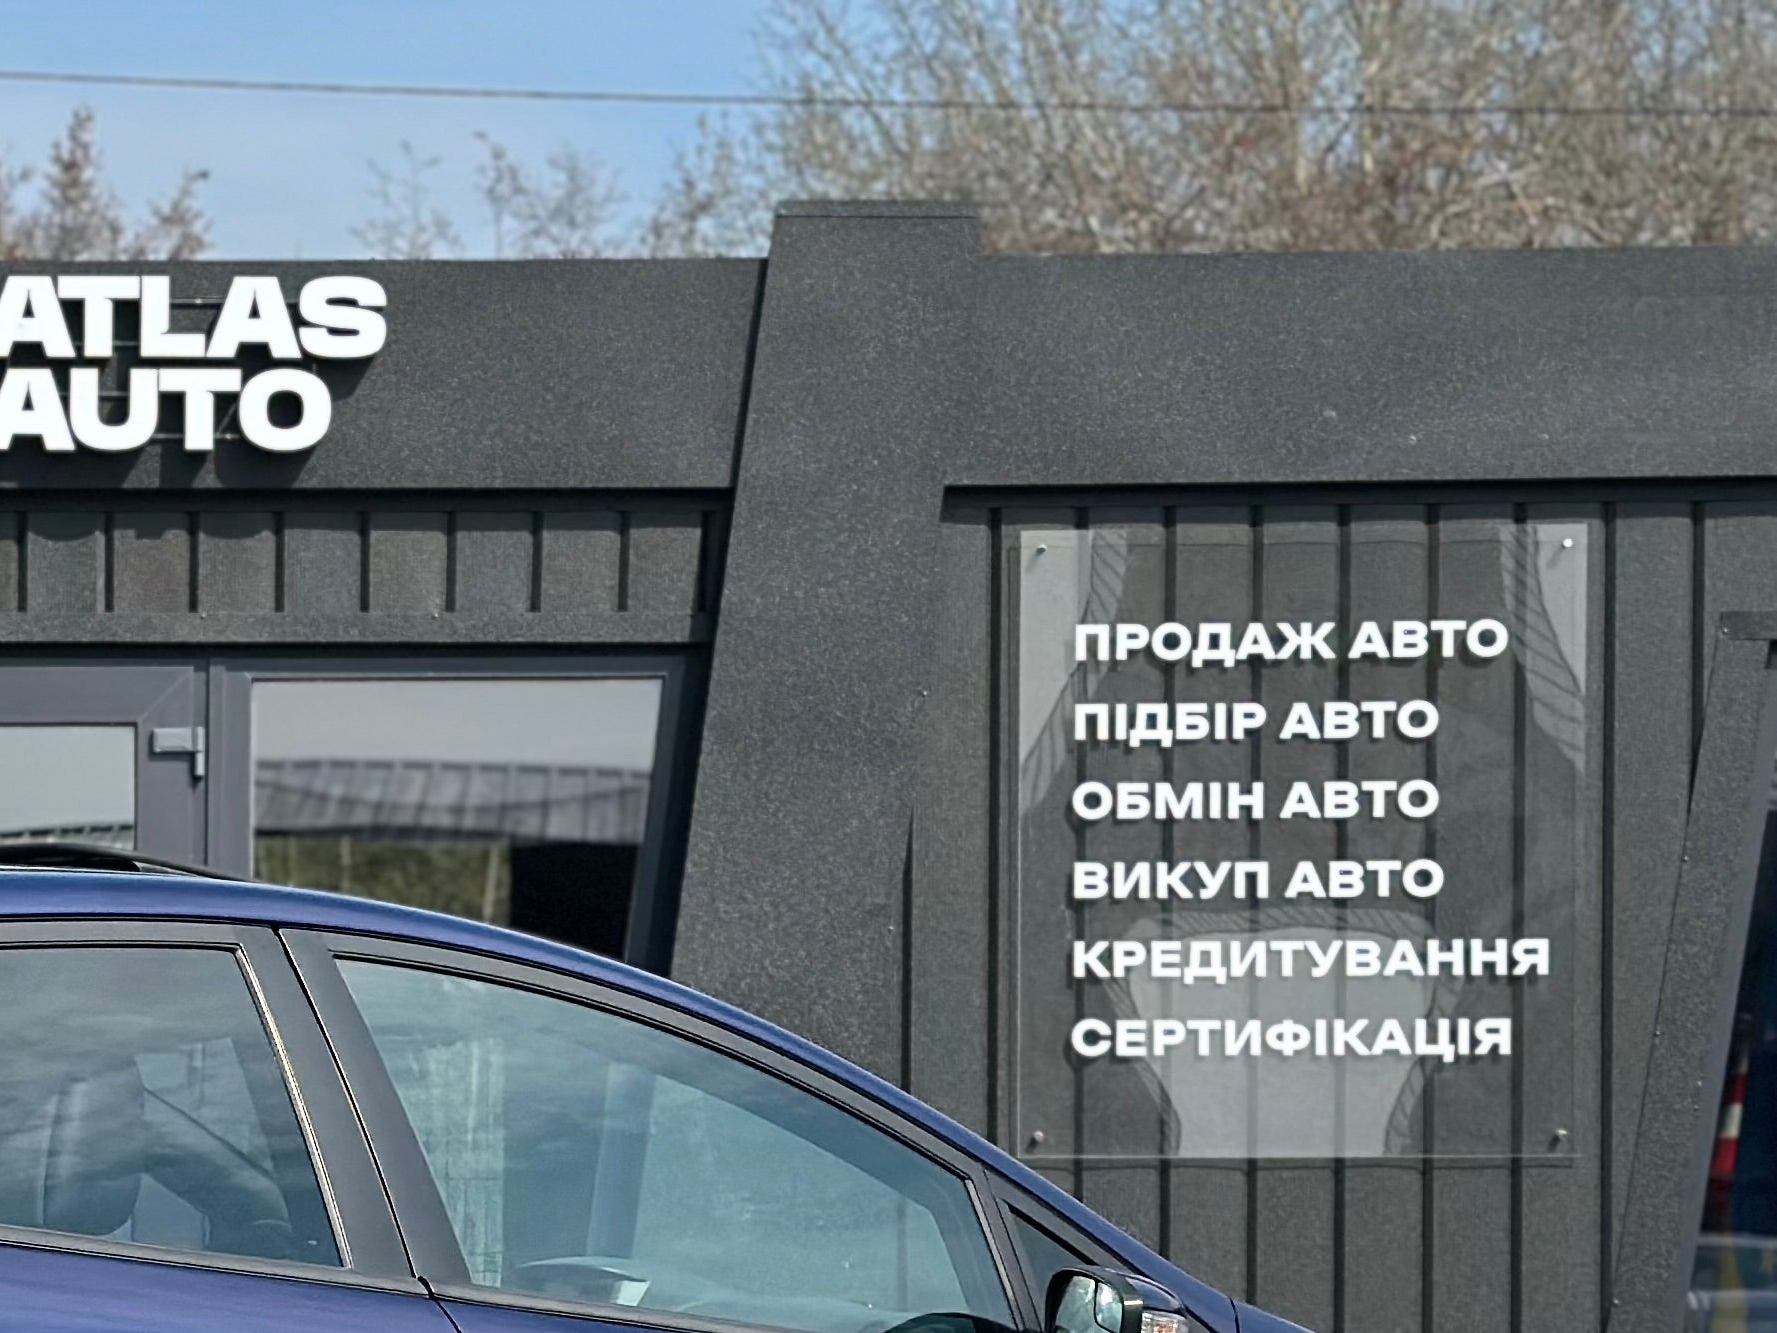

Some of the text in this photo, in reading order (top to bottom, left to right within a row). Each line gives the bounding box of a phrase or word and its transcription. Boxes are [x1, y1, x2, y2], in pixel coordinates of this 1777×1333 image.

[1074, 618, 1509, 668] ПРОДАЖ АВТО
[1074, 699, 1440, 748] ПІДБІР АВТО
[1072, 779, 1440, 820] ОБМІН АВТО
[1073, 858, 1444, 900] ВИКУП АВТО
[1073, 938, 1550, 986] КРЕДИТУВАННЯ
[1071, 1017, 1512, 1063] СЕРТИФІКАЦІЯ
